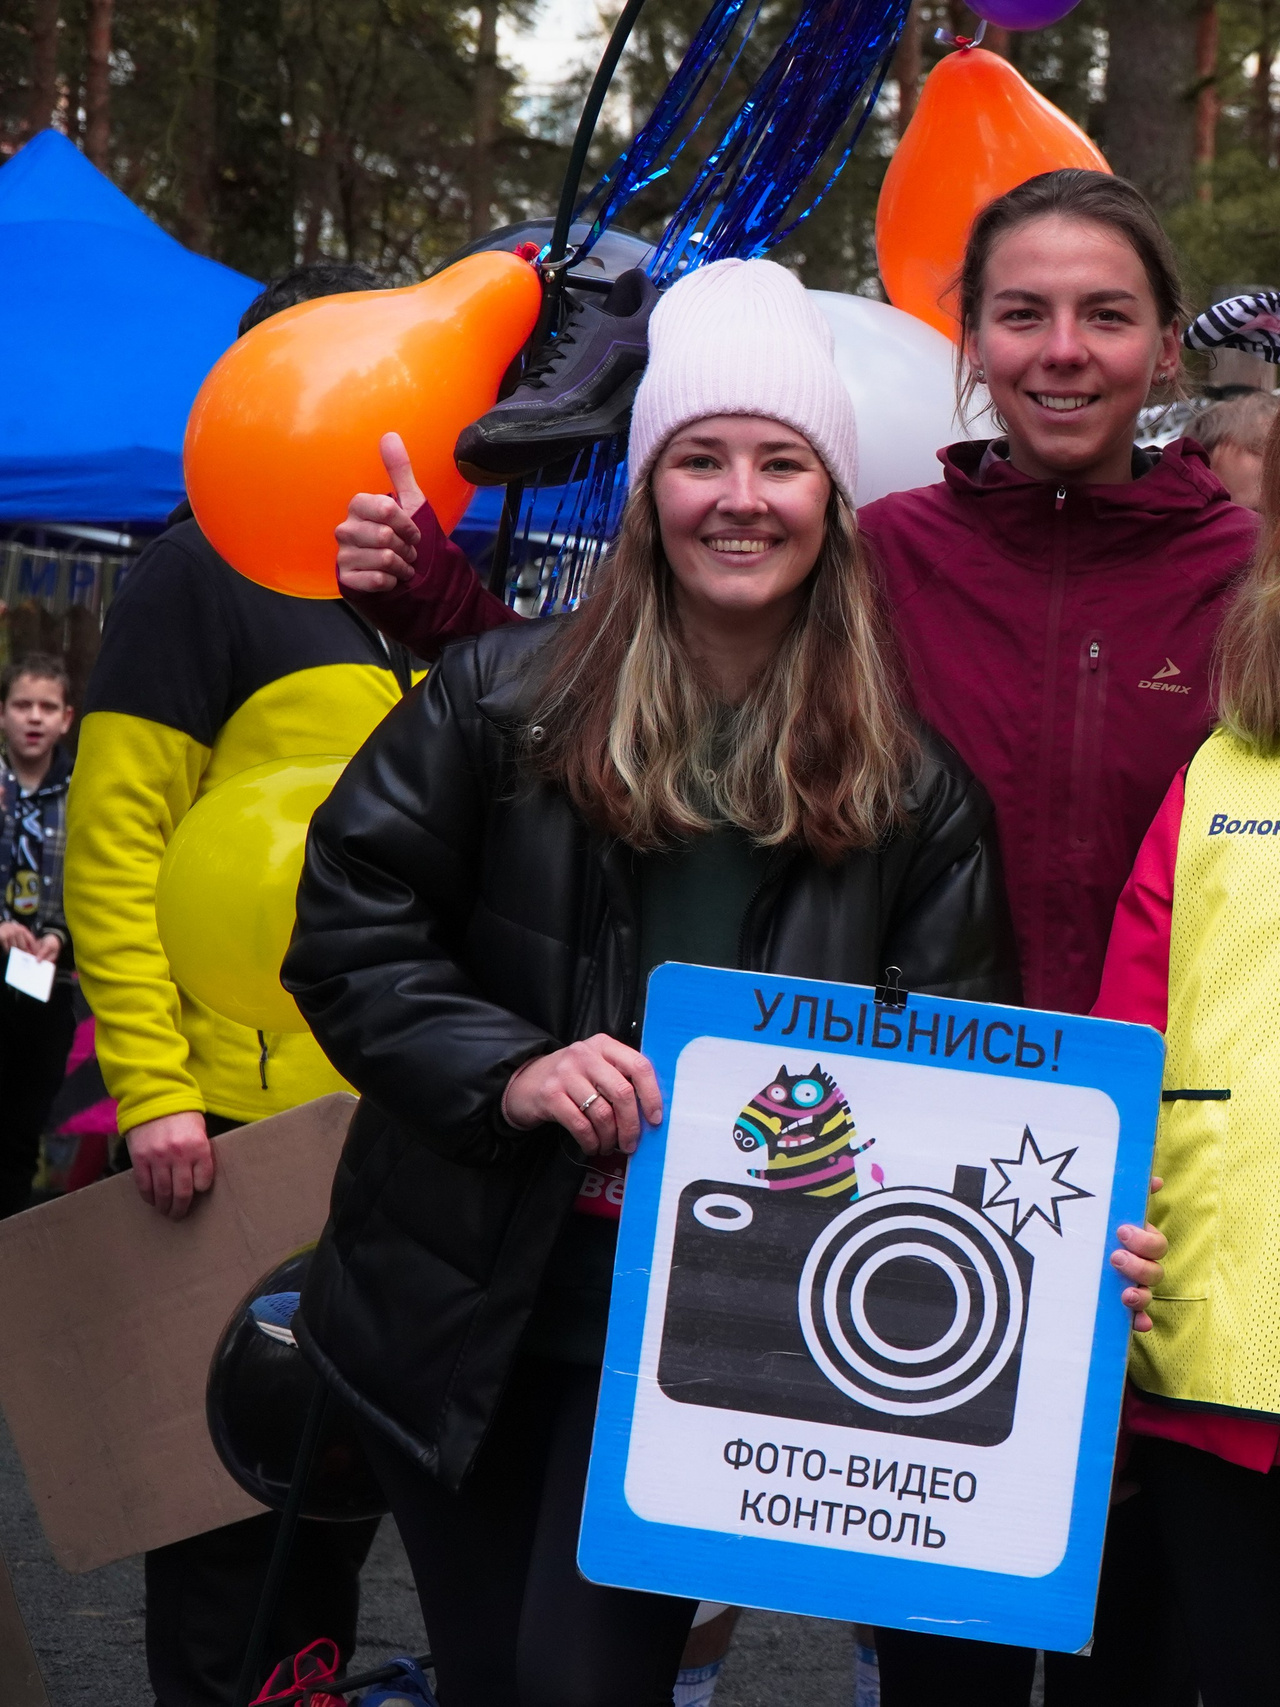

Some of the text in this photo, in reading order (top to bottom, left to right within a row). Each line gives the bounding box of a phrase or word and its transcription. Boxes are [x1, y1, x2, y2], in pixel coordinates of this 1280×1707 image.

[1137, 680, 1192, 695] DEMIX
[752, 987, 1065, 1072] УЛЫБНИСЬ!
[723, 1438, 978, 1504] ФОТО-ВИДЕО
[740, 1489, 947, 1549] КОНТРОЛЬ
